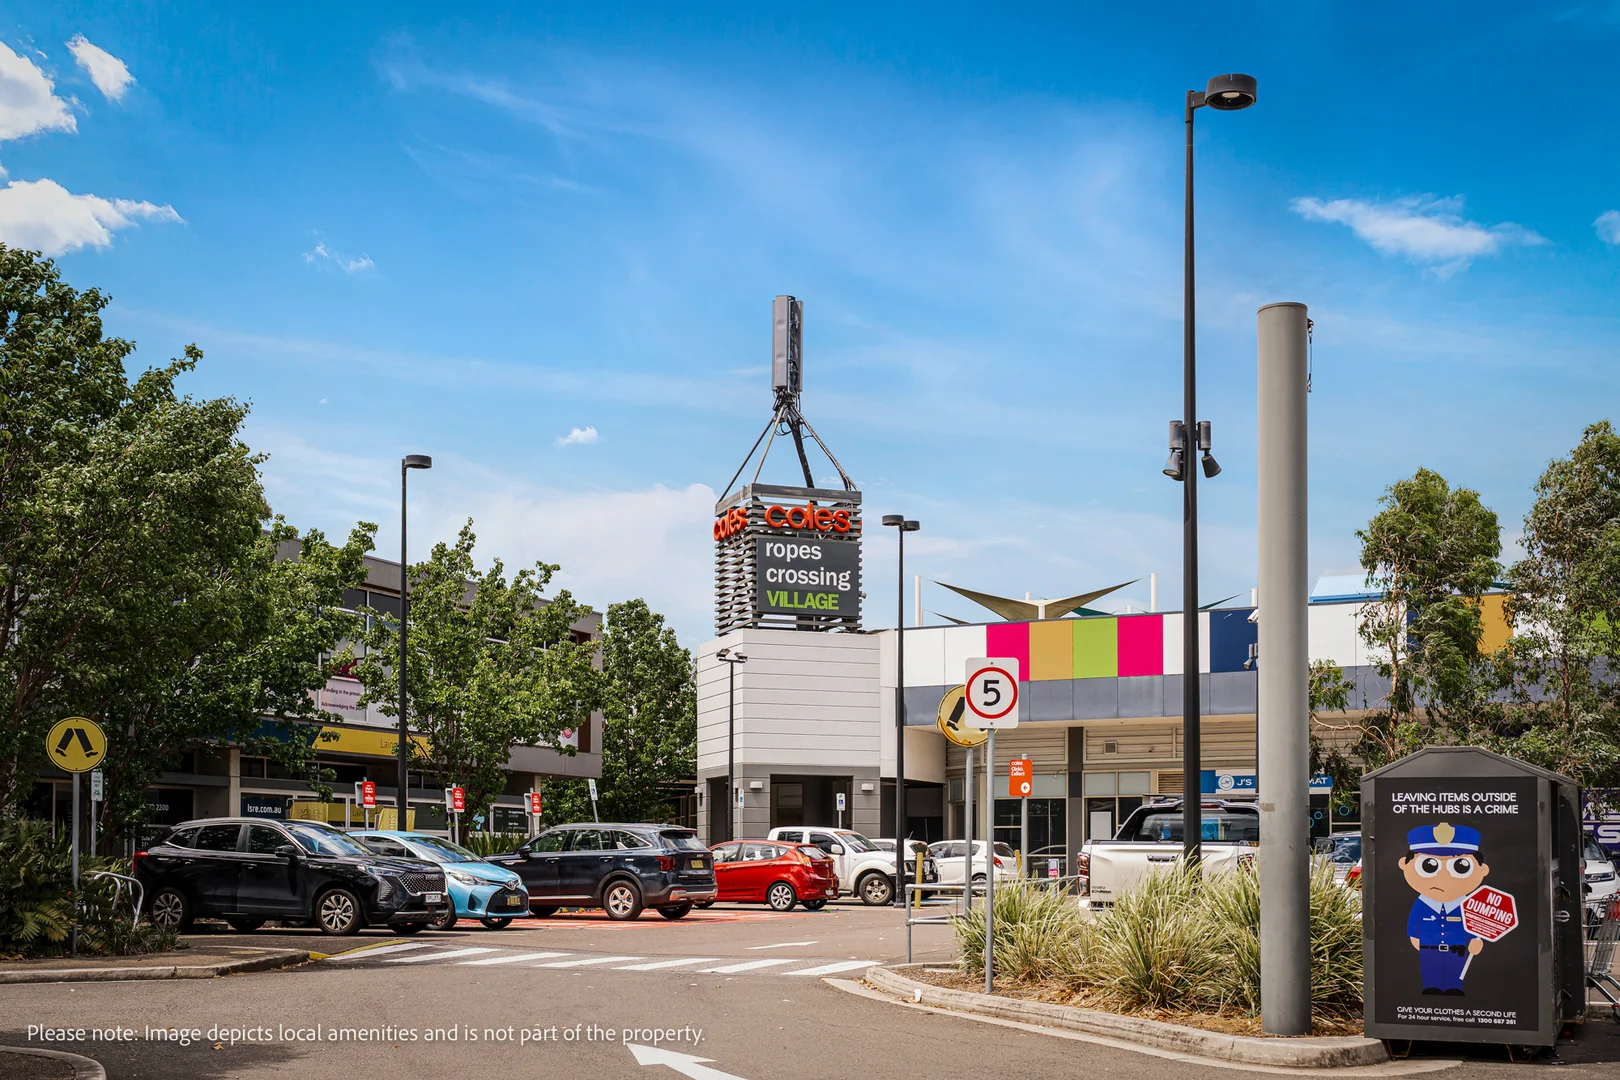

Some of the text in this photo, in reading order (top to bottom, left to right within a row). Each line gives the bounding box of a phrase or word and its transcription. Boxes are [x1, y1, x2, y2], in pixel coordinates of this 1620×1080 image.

[714, 508, 747, 541] coles
[765, 502, 851, 533] coles
[765, 542, 822, 562] ropes
[766, 567, 851, 591] crossing
[766, 590, 840, 610] VILLAGE
[983, 679, 1001, 707] 5
[1392, 792, 1517, 802] LEAVING ITEMS OUTSIDE
[1393, 804, 1519, 814] OF THE HUBS IS A CRIME
[1486, 892, 1502, 907] NO
[1466, 898, 1513, 925] DUMPING
[1434, 1008, 1465, 1016] CLOTHES
[1473, 1009, 1502, 1017] SECOND
